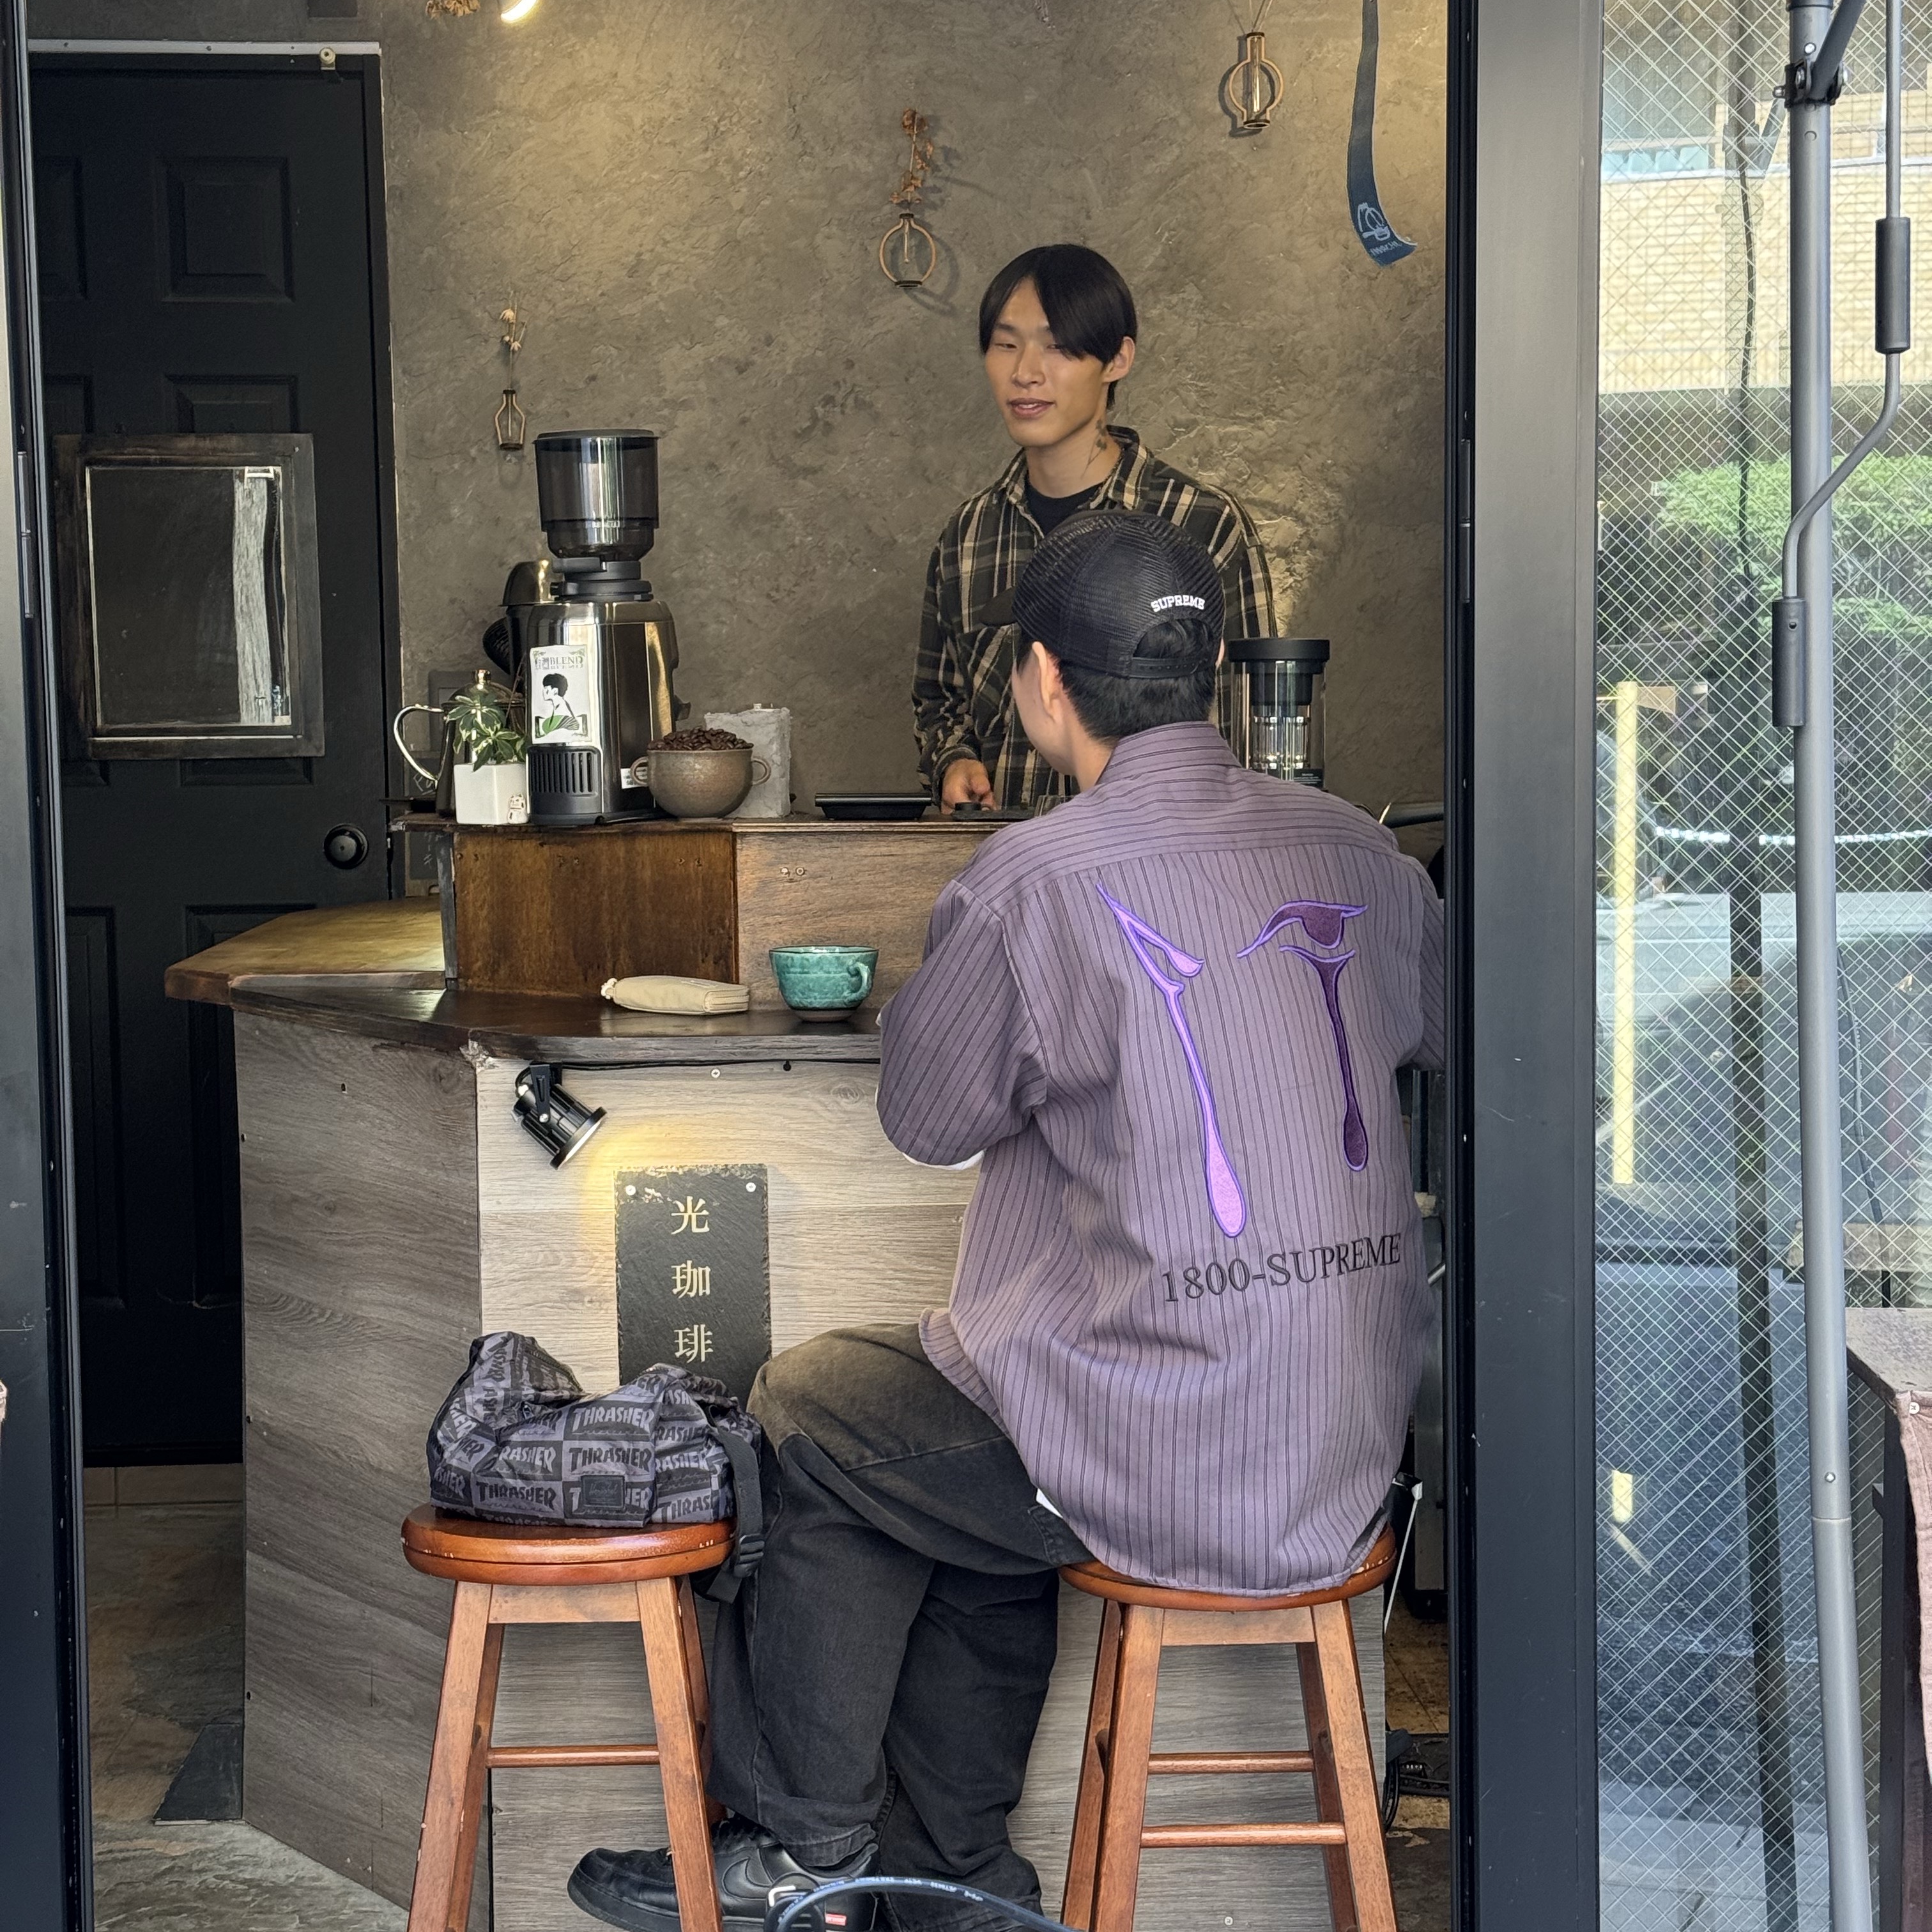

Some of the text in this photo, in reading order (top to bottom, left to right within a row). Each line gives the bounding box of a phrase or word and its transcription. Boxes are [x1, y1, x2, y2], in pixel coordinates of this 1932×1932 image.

[1150, 594, 1206, 613] SUPREME
[671, 1195, 714, 1363] 光珈琲
[1162, 1232, 1401, 1303] 1800-SUPREME
[572, 1406, 655, 1434] THRASHER
[569, 1447, 652, 1473] THRASHER
[475, 1481, 556, 1511] THRASHER
